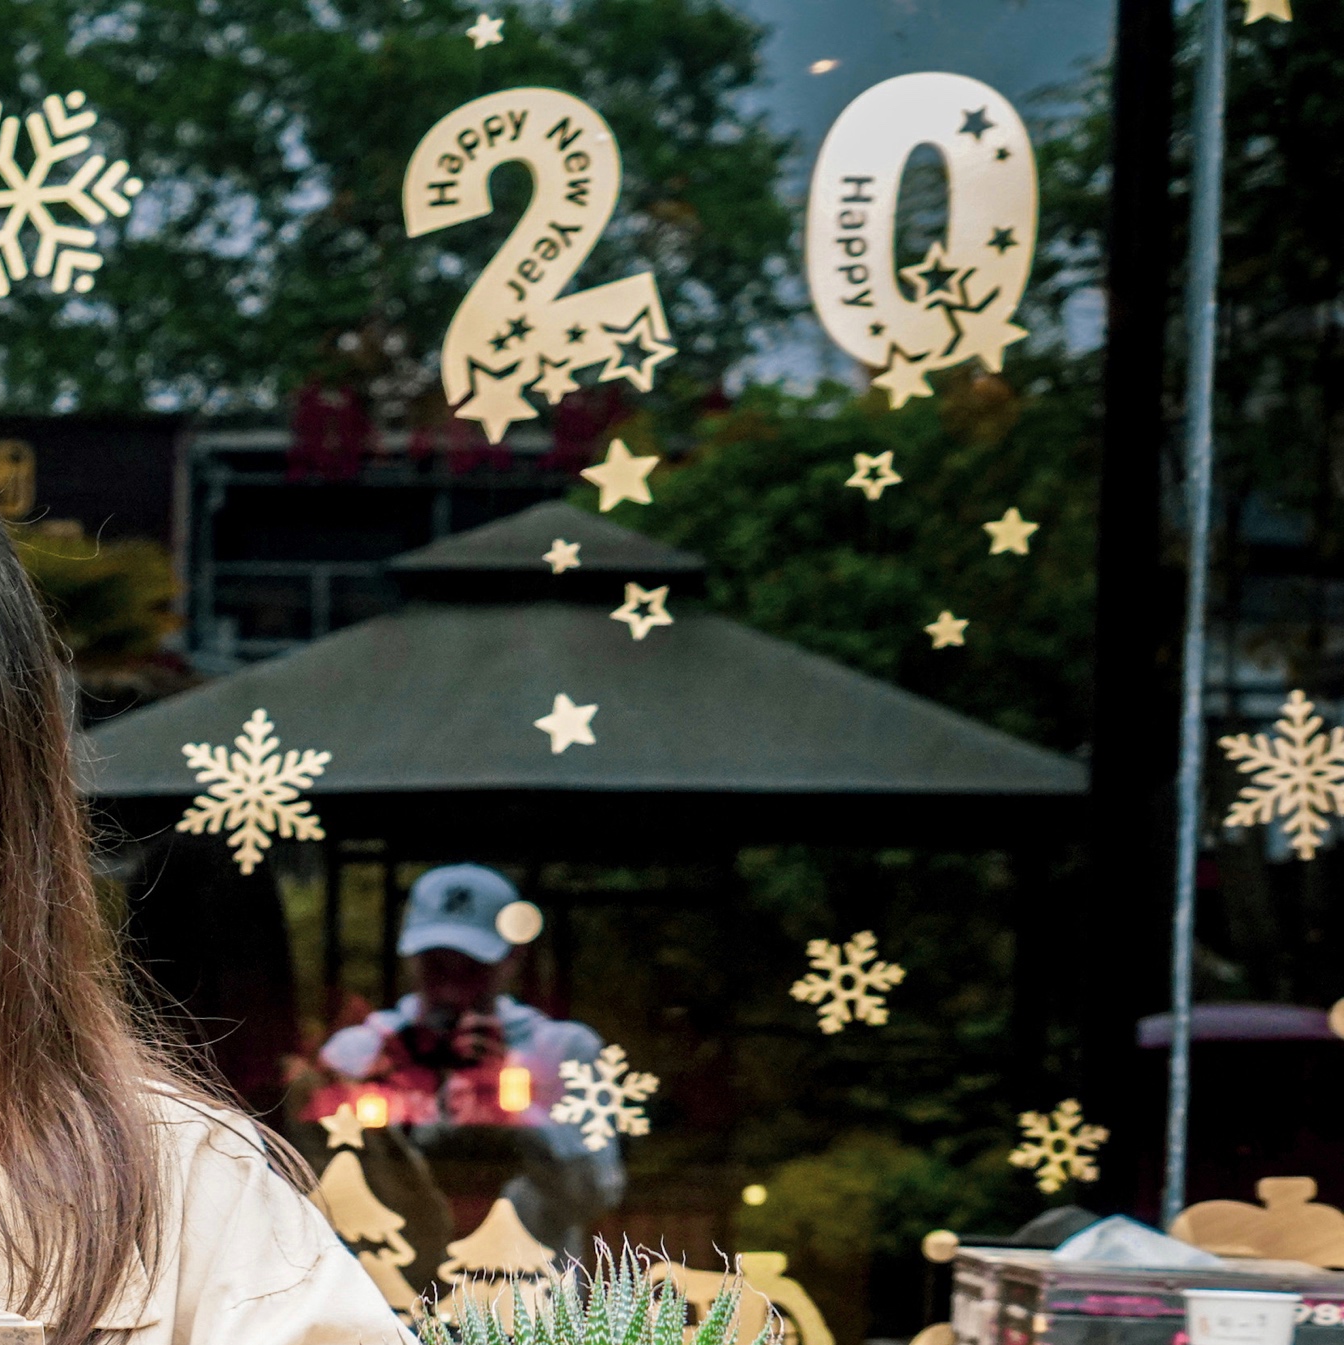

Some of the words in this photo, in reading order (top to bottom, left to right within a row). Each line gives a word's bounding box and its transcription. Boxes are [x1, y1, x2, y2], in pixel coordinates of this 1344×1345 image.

[426, 109, 528, 208] Happy
[544, 116, 592, 207] New
[505, 220, 584, 303] Year
[833, 175, 876, 308] Happy
